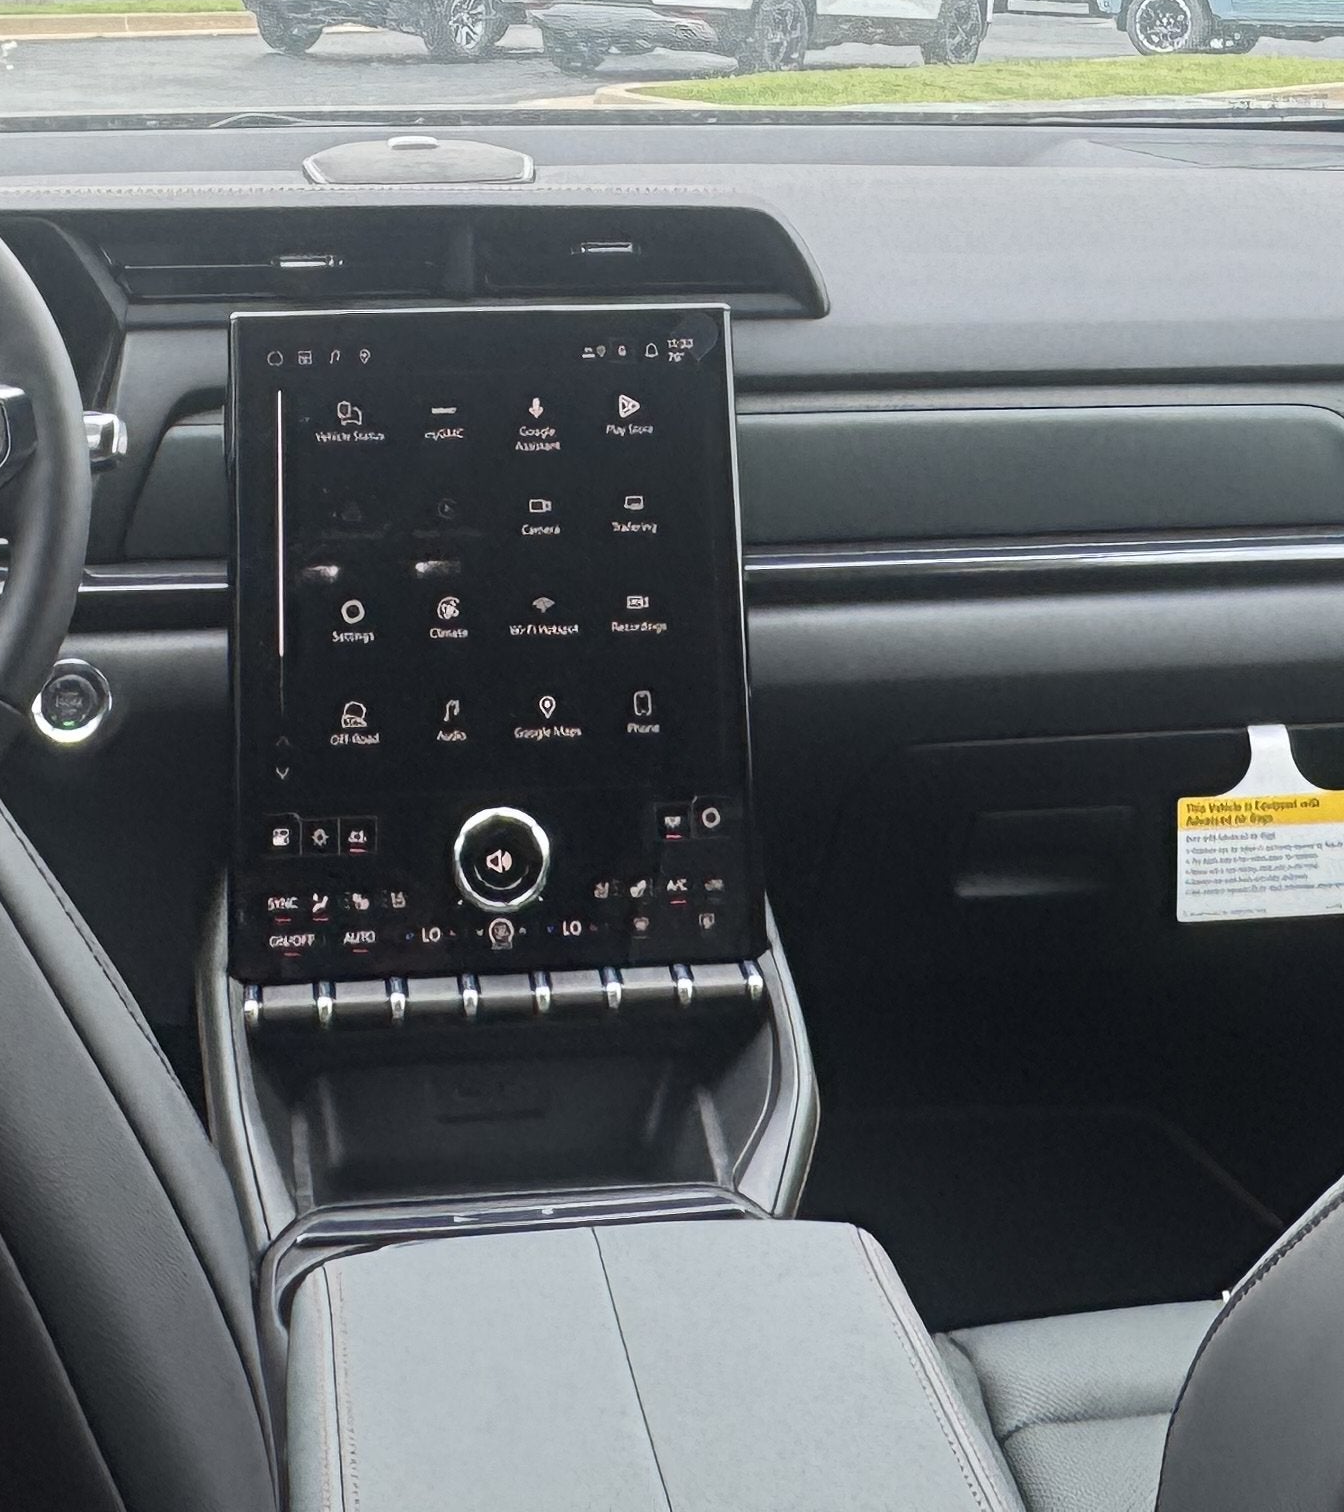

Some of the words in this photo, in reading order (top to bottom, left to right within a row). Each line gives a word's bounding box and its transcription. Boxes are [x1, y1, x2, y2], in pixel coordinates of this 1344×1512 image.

[606, 424, 626, 436] Play
[521, 524, 561, 535] Camera
[332, 630, 375, 644] Settings
[429, 628, 469, 639] Climate
[514, 726, 551, 740] Google
[554, 725, 582, 738] Maps
[627, 722, 660, 734] Phone
[437, 730, 467, 741] Audio
[267, 897, 299, 911] SYNC
[421, 927, 441, 943] LO
[562, 920, 582, 936] LO
[343, 930, 376, 944] AUTO
